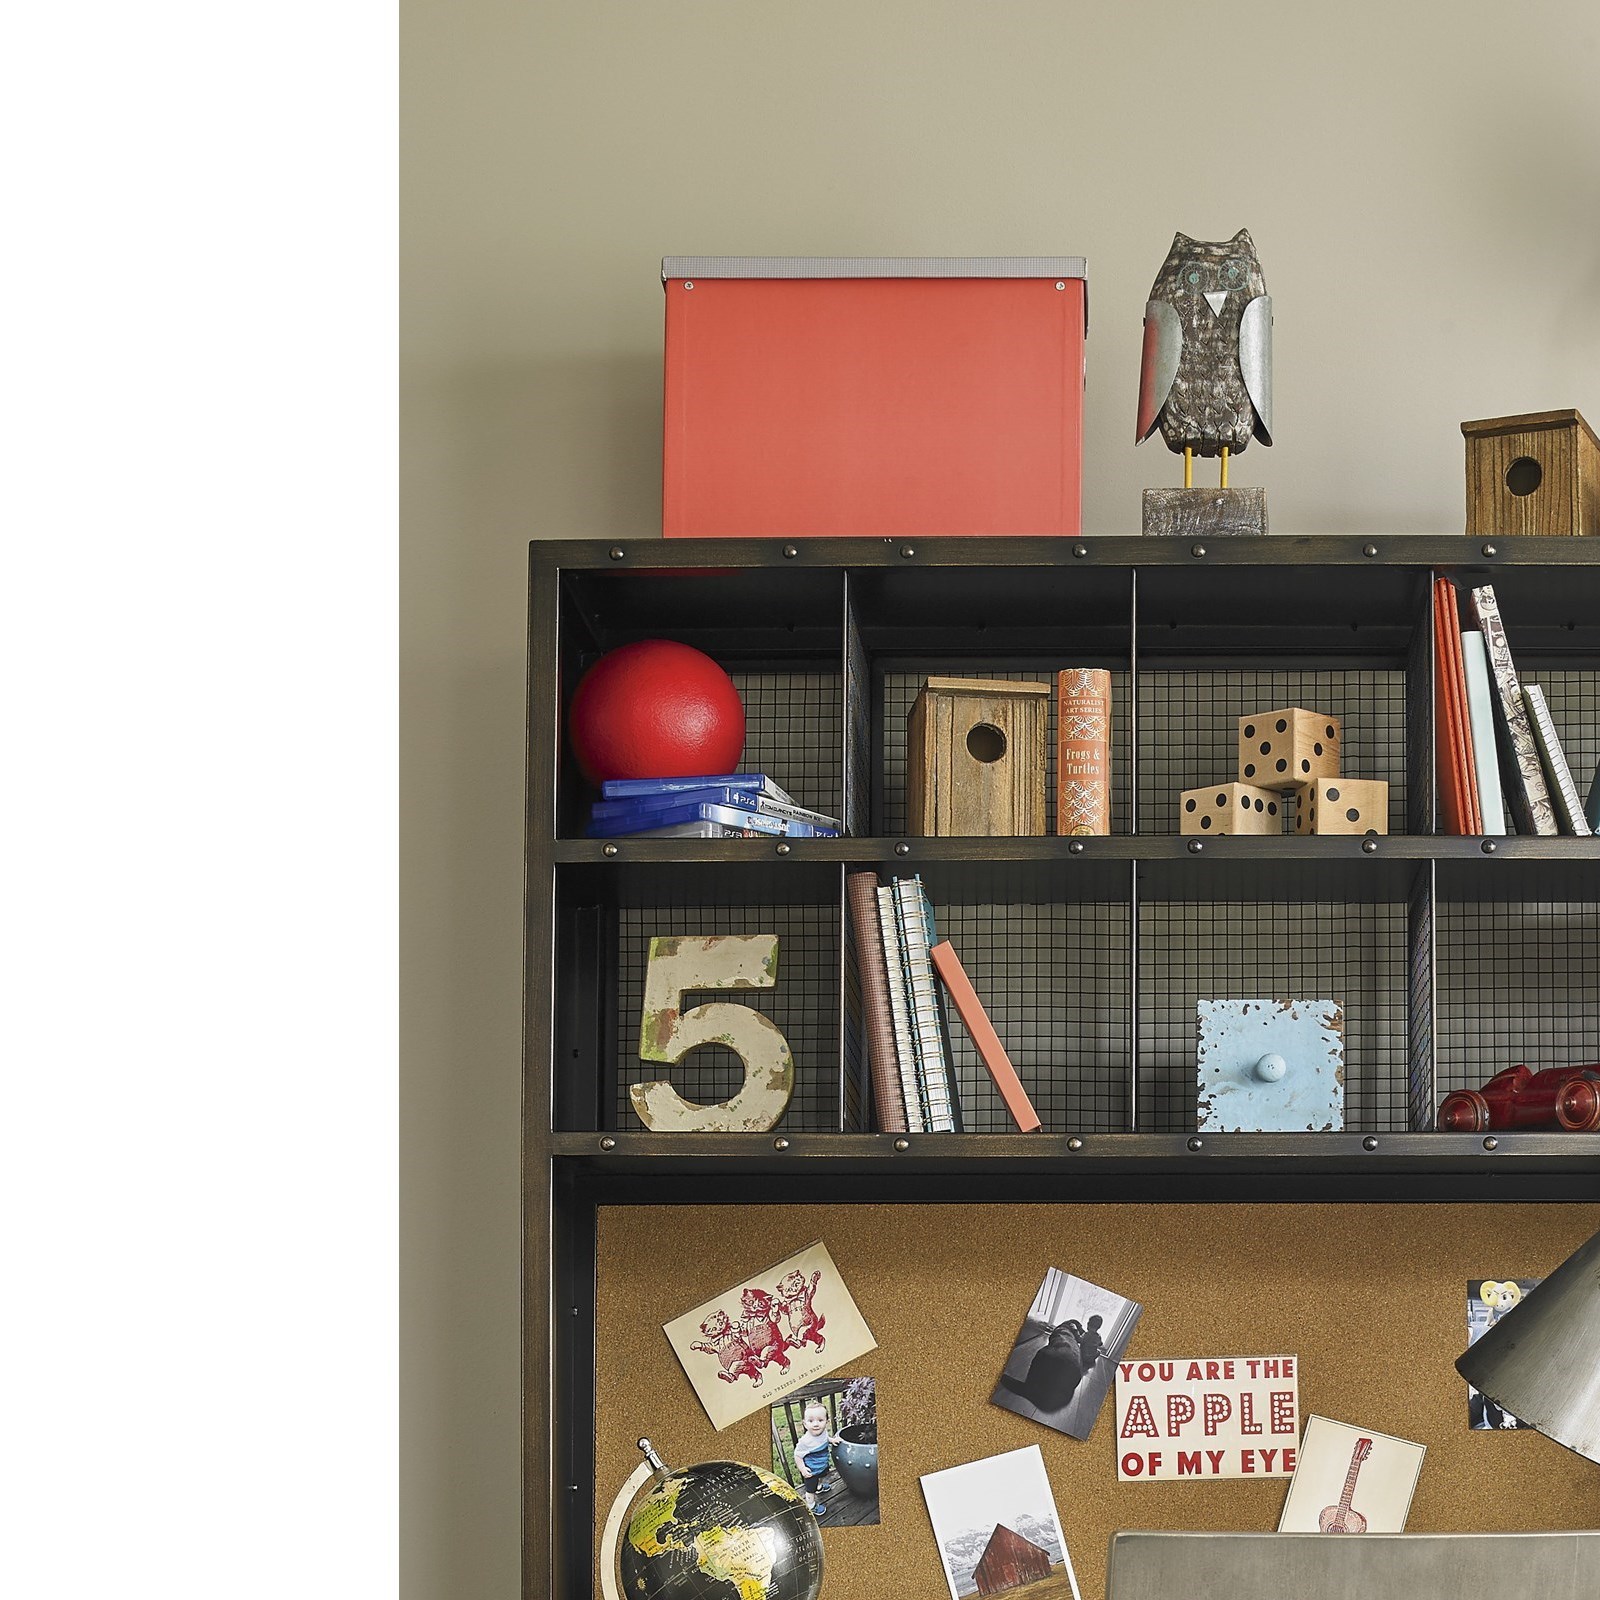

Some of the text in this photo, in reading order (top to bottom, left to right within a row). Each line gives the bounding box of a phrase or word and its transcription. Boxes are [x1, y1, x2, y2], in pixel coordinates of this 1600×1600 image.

[1063, 699, 1105, 707] NATURALIST
[1080, 706, 1103, 714] SERIES
[1066, 748, 1101, 761] Frogs &
[1066, 762, 1100, 775] Turtles
[740, 795, 755, 806] PS4
[631, 934, 795, 1133] 5
[1118, 1359, 1293, 1383] YOU ARE THE
[1120, 1391, 1295, 1439] APPLE
[1121, 1448, 1296, 1477] OF MY EYE
